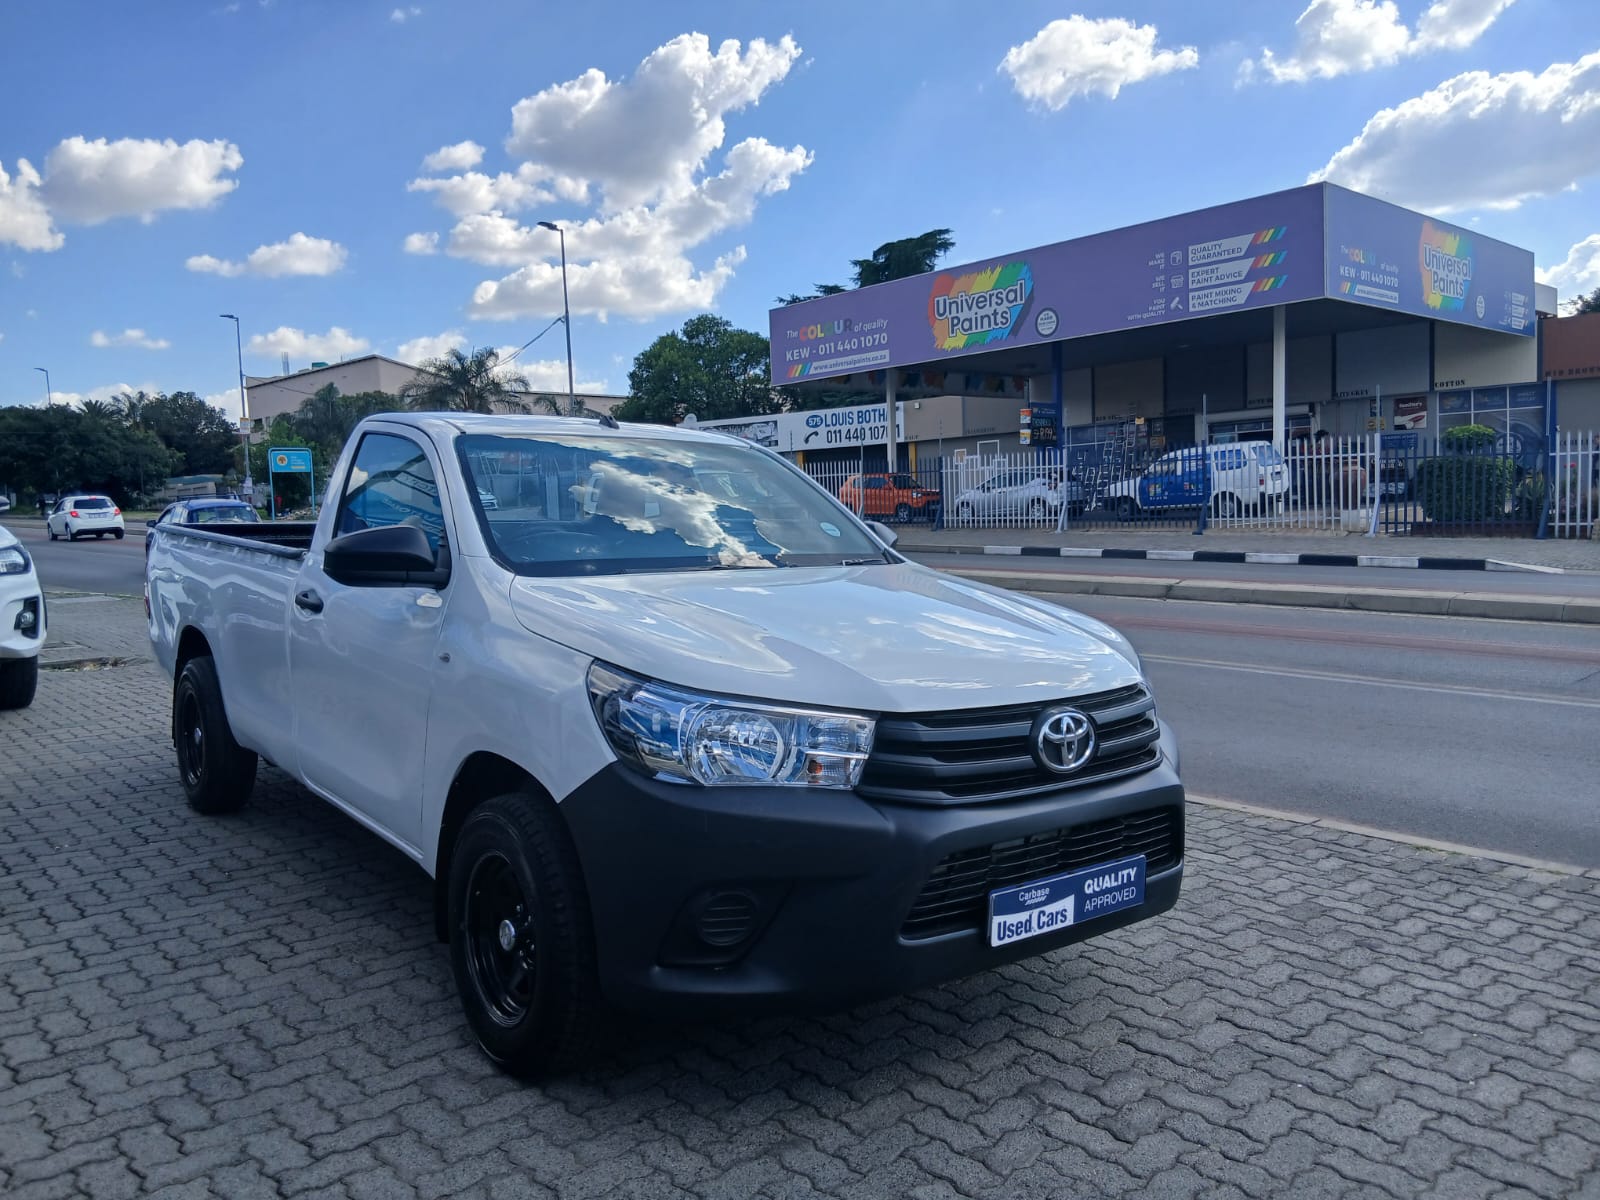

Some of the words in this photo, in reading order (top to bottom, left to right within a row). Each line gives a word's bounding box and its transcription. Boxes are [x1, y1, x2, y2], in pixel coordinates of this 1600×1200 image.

[1191, 243, 1223, 255] QUALITY
[1191, 247, 1242, 262] GUARANTEED
[1191, 267, 1219, 278] EXPERT
[1424, 246, 1471, 279] Universal
[1191, 276, 1214, 286] PAINT
[1215, 271, 1242, 282] ADVICE
[1340, 265, 1356, 278] KEW
[1384, 275, 1398, 287] 1070
[1432, 271, 1464, 297] Paints
[935, 280, 1024, 319] Universal
[1191, 291, 1214, 302] PAINT
[1215, 287, 1242, 297] MIXING
[1198, 296, 1237, 308] MATCHING
[787, 330, 798, 339] The
[799, 319, 852, 341] COLOUR
[854, 323, 863, 332] of
[863, 319, 888, 331] quality
[950, 307, 1010, 336] Paints
[786, 347, 810, 361] KEW
[818, 342, 835, 355] 011
[837, 338, 858, 352] 440
[860, 333, 888, 348] 1070
[1434, 379, 1465, 388] COTTON
[824, 411, 854, 427] LOUIS
[857, 408, 888, 424] BOTH
[826, 429, 842, 443] 011
[845, 428, 866, 442] 440
[1084, 867, 1137, 894] QUALITY
[1019, 887, 1050, 901] Carbase
[1084, 887, 1136, 912] APPROVED
[997, 912, 1033, 941] Used
[1037, 908, 1067, 930] Cars
